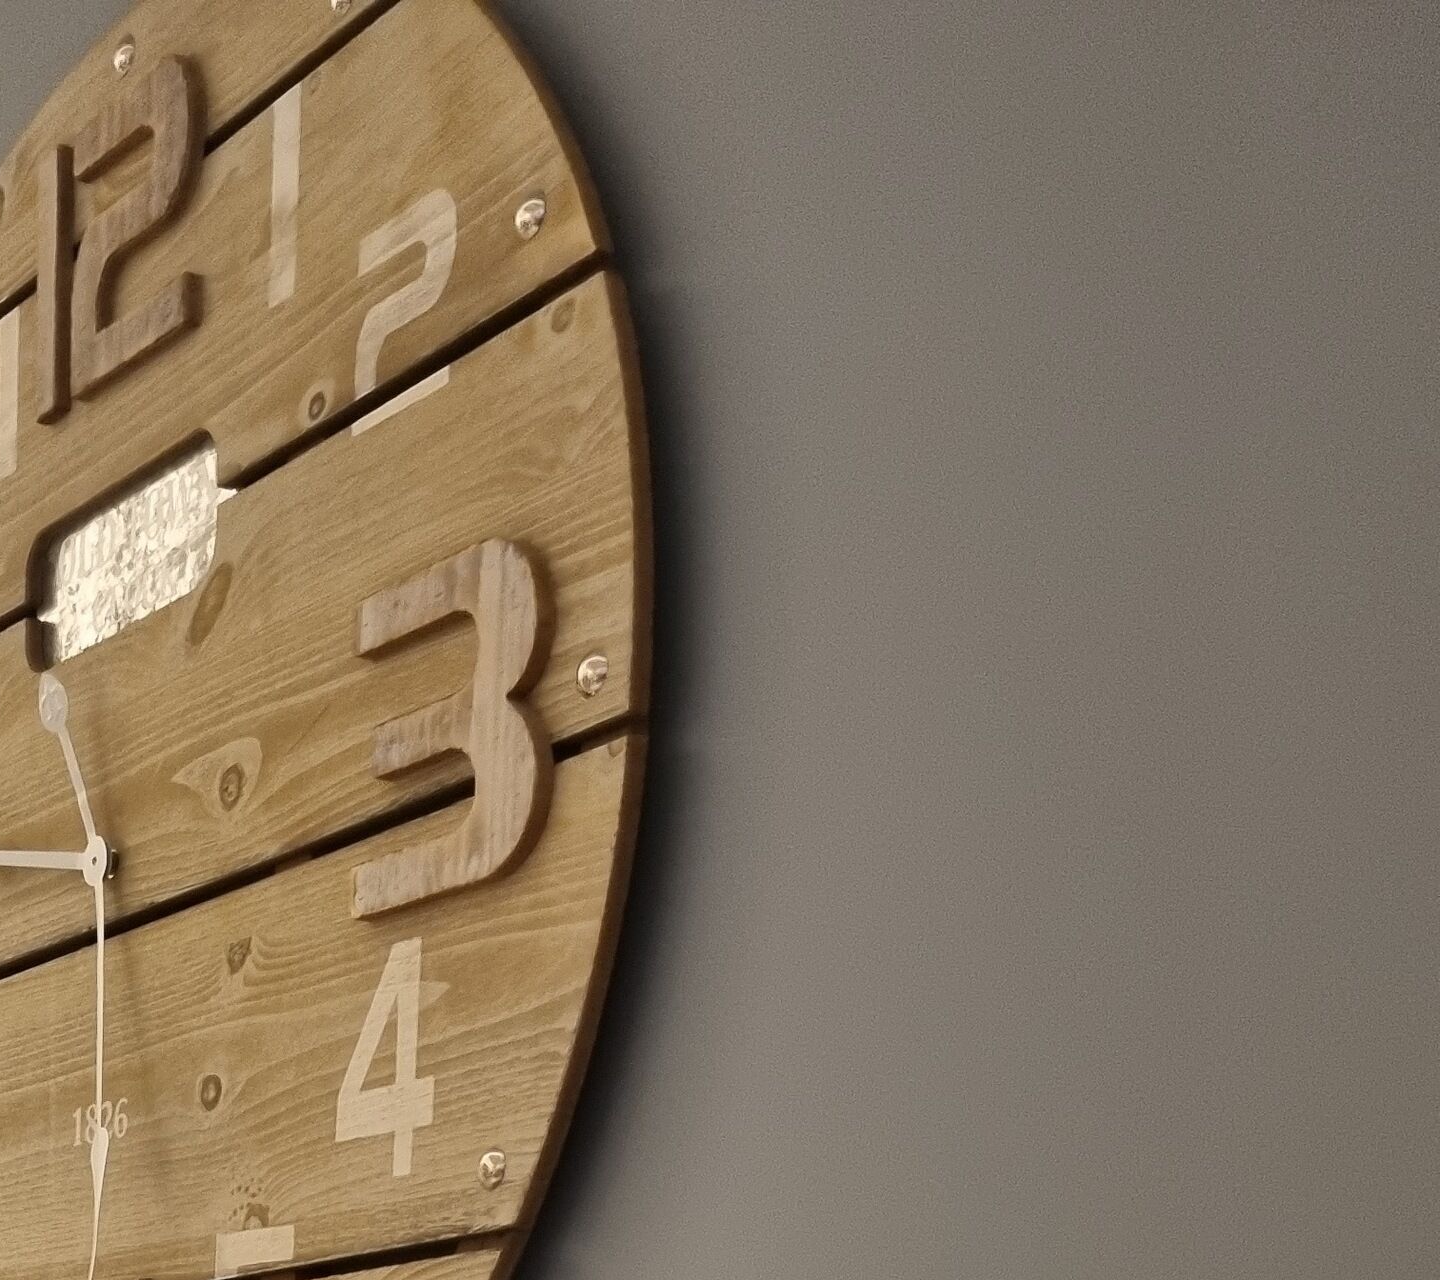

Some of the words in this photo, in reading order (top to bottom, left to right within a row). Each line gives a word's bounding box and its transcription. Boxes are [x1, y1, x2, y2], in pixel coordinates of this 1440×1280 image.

[36, 53, 206, 425] 12
[268, 84, 302, 308] 1
[351, 189, 458, 437] 2
[353, 538, 558, 920] 3
[335, 936, 436, 1177] 4
